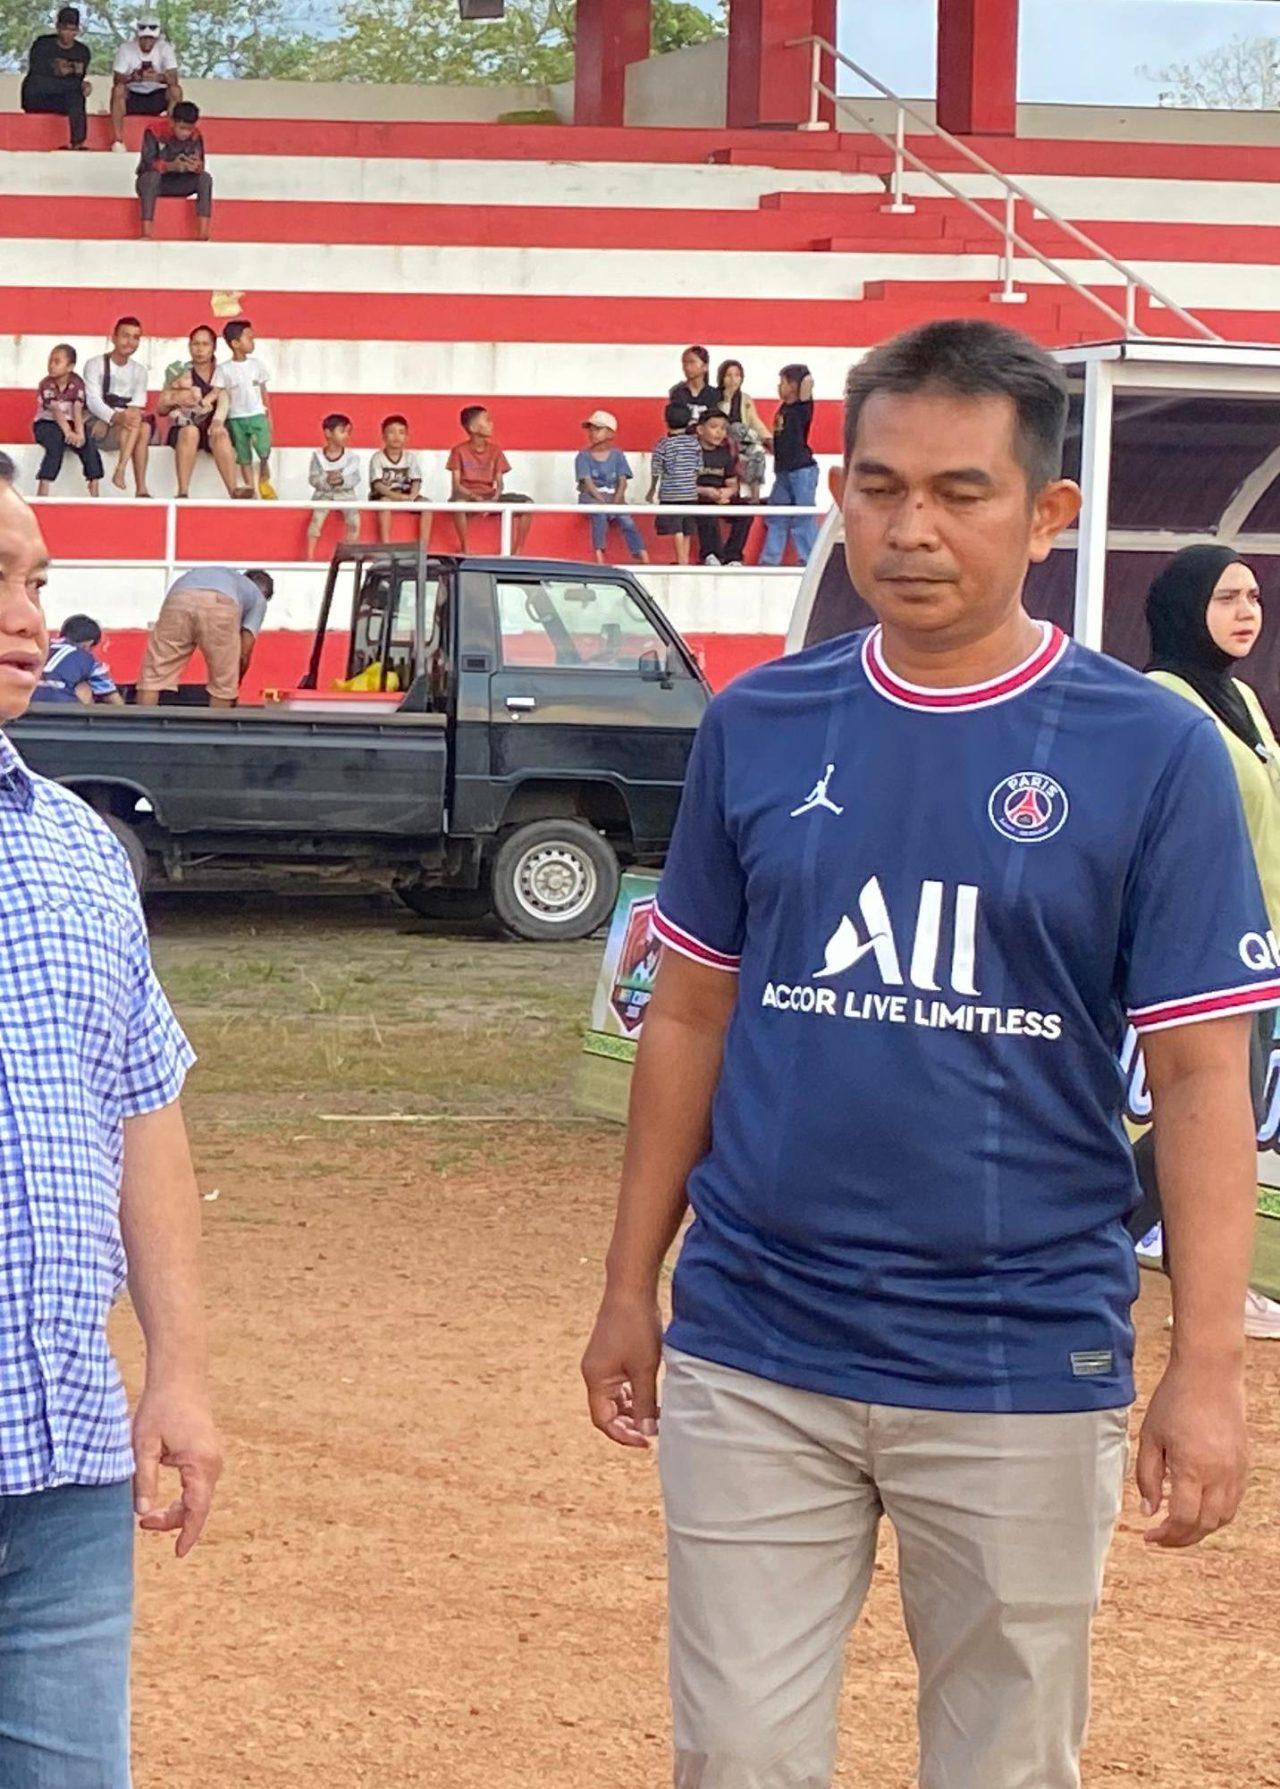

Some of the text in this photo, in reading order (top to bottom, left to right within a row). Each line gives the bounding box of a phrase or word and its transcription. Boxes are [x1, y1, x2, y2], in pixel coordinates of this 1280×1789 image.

[1007, 775, 1059, 798] PARIS
[762, 981, 1062, 1041] ACCOR LIVE LIMITLESS
